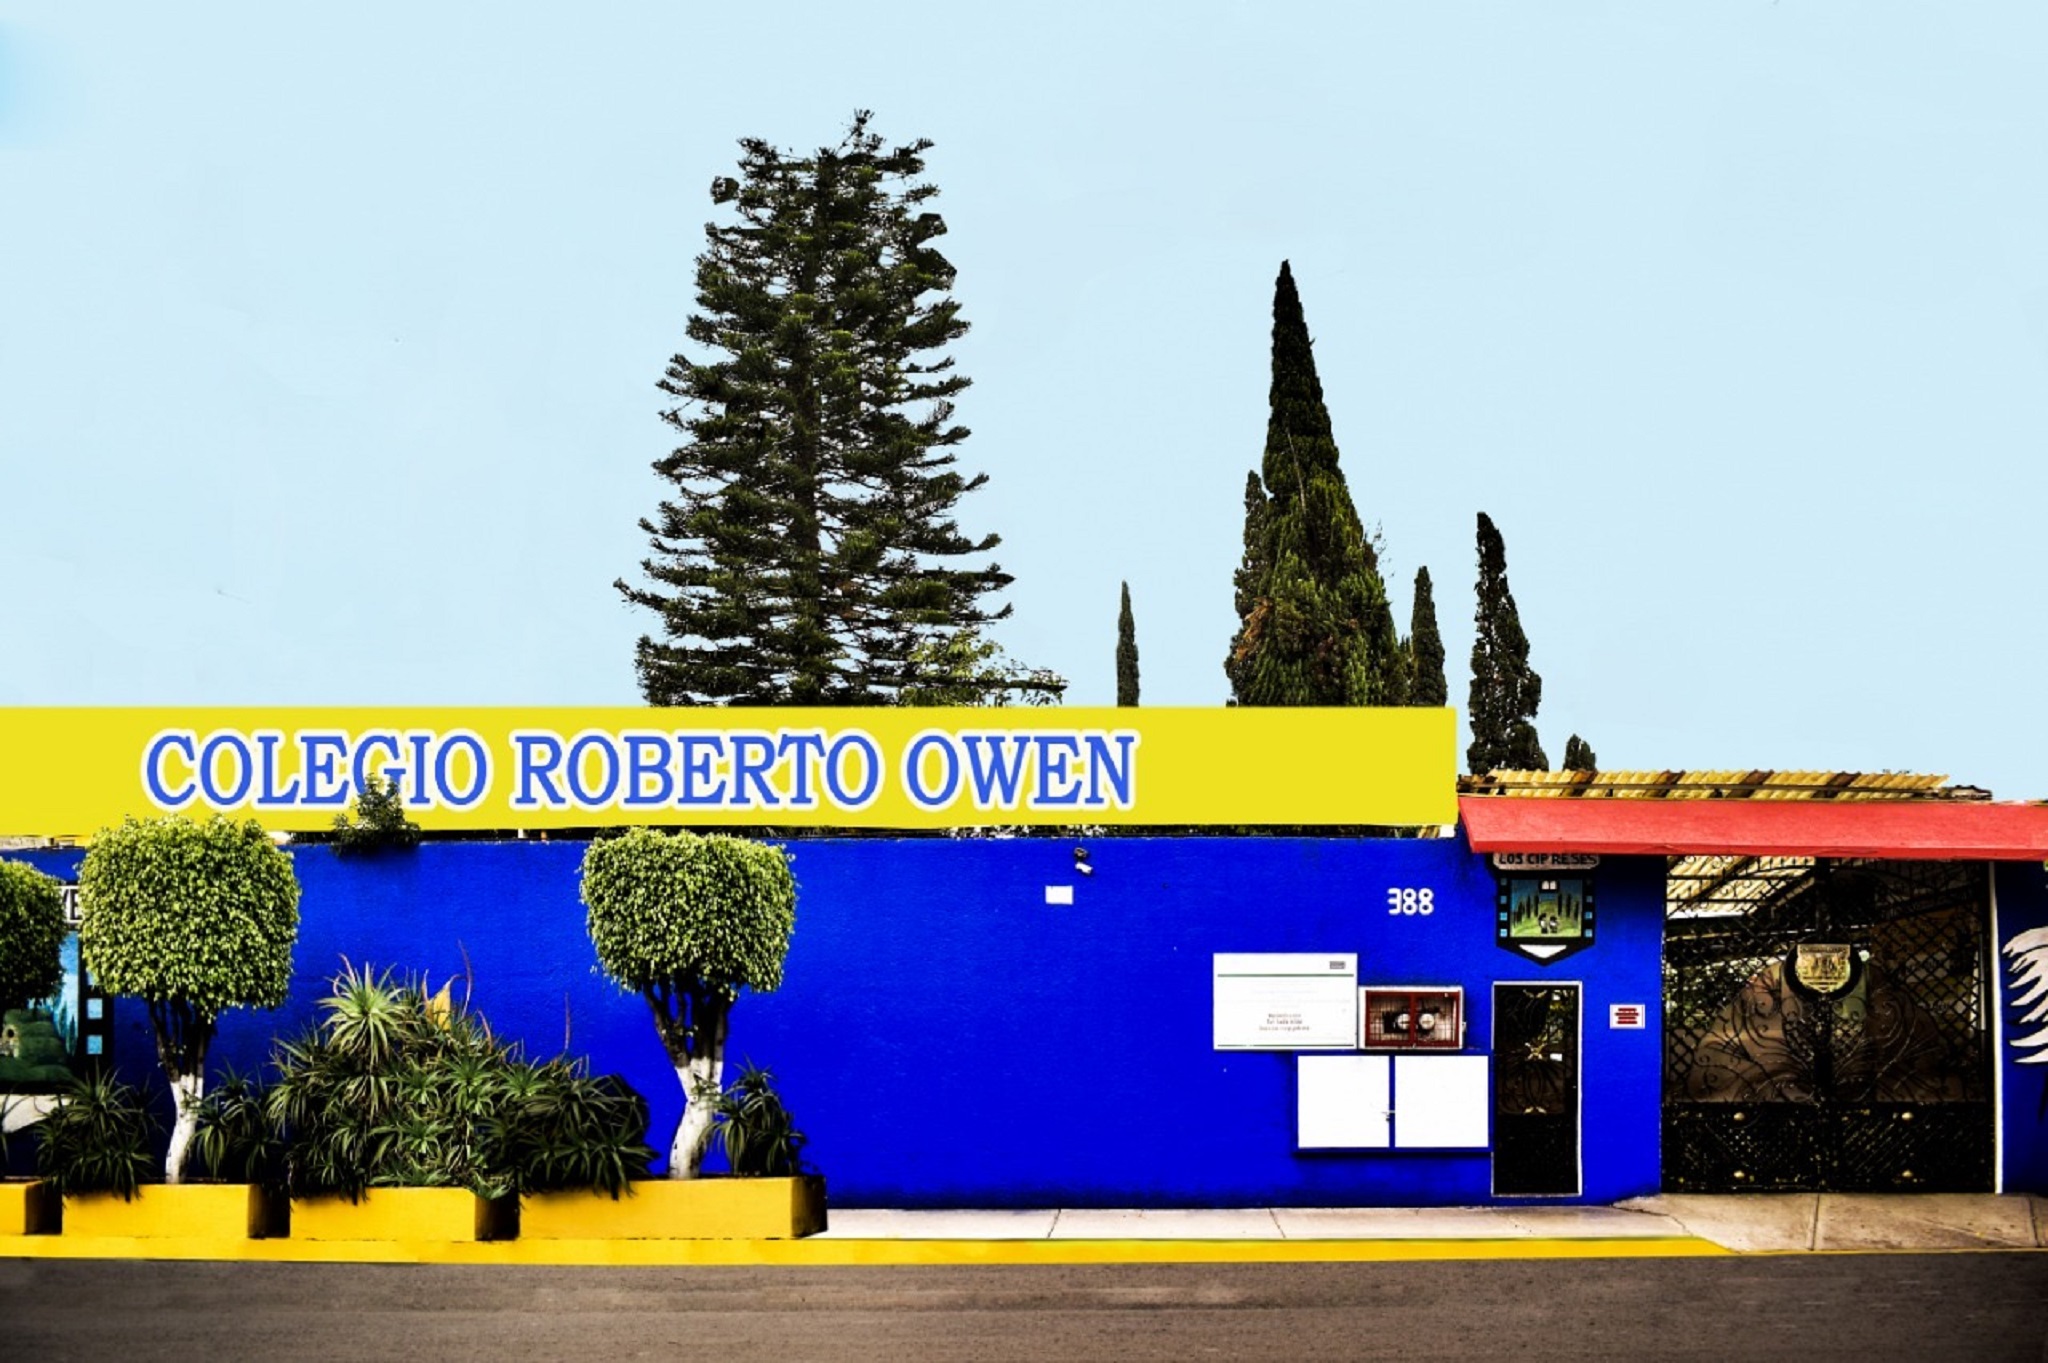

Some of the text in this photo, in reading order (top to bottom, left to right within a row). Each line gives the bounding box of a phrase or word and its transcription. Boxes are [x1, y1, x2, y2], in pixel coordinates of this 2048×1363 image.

[147, 734, 1135, 806] COLEGIO ROBERTO OWEN
[1499, 853, 1523, 865] LOS
[1387, 887, 1434, 916] 388
